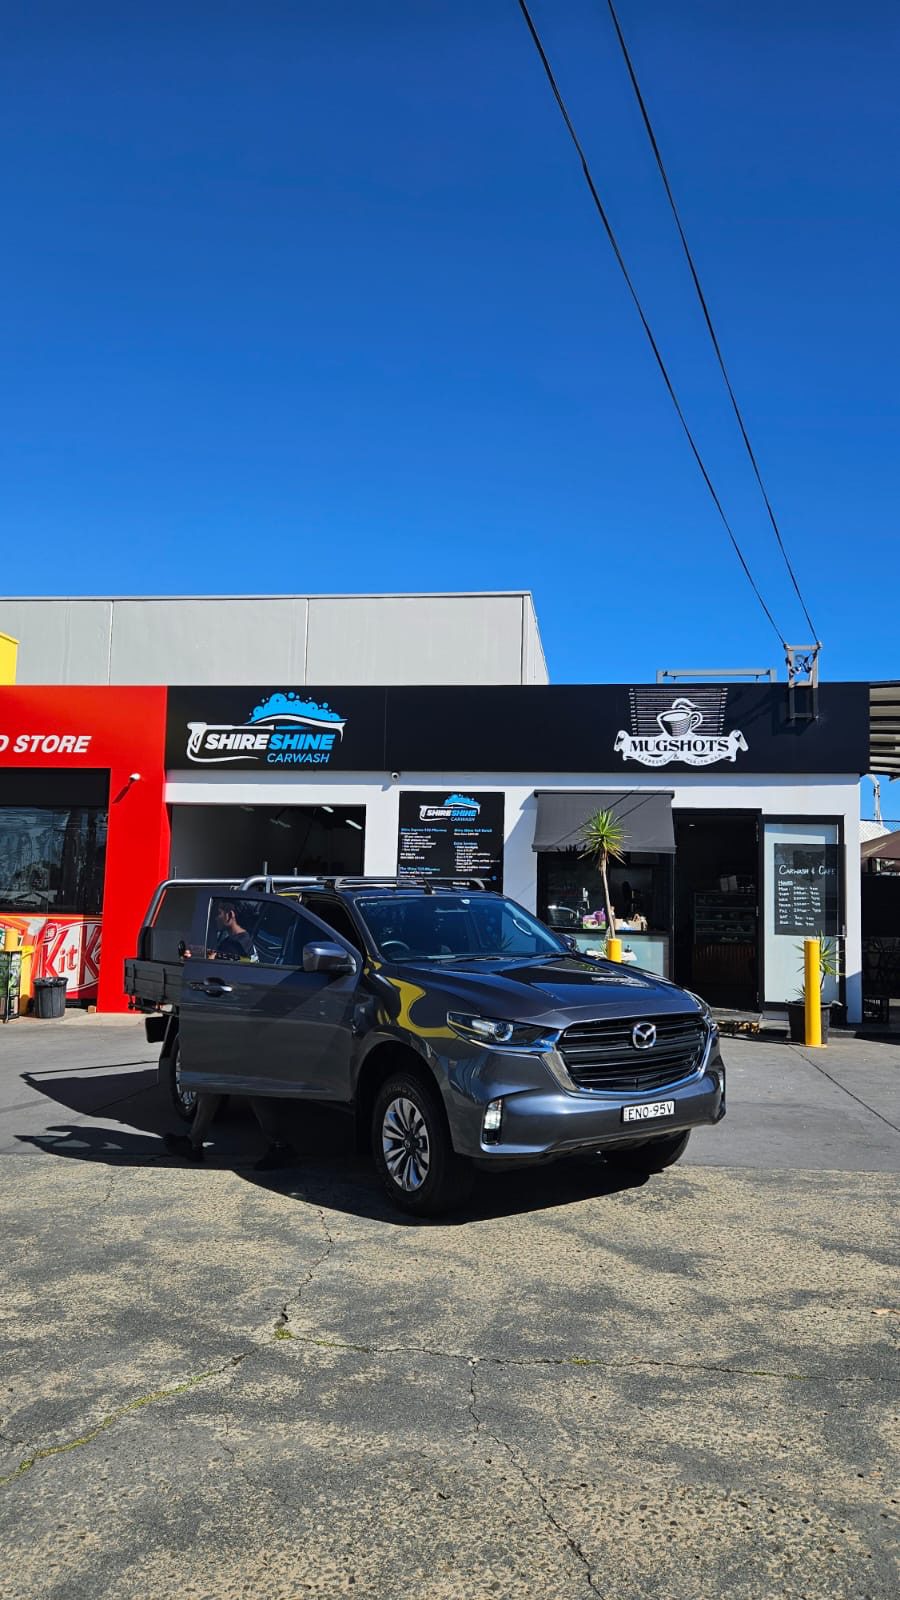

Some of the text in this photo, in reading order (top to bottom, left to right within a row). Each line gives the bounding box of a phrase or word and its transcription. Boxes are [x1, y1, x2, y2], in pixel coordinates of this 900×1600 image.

[13, 735, 92, 753] STORE
[630, 739, 729, 752] MUGSHOTS
[267, 752, 330, 763] CARWASH
